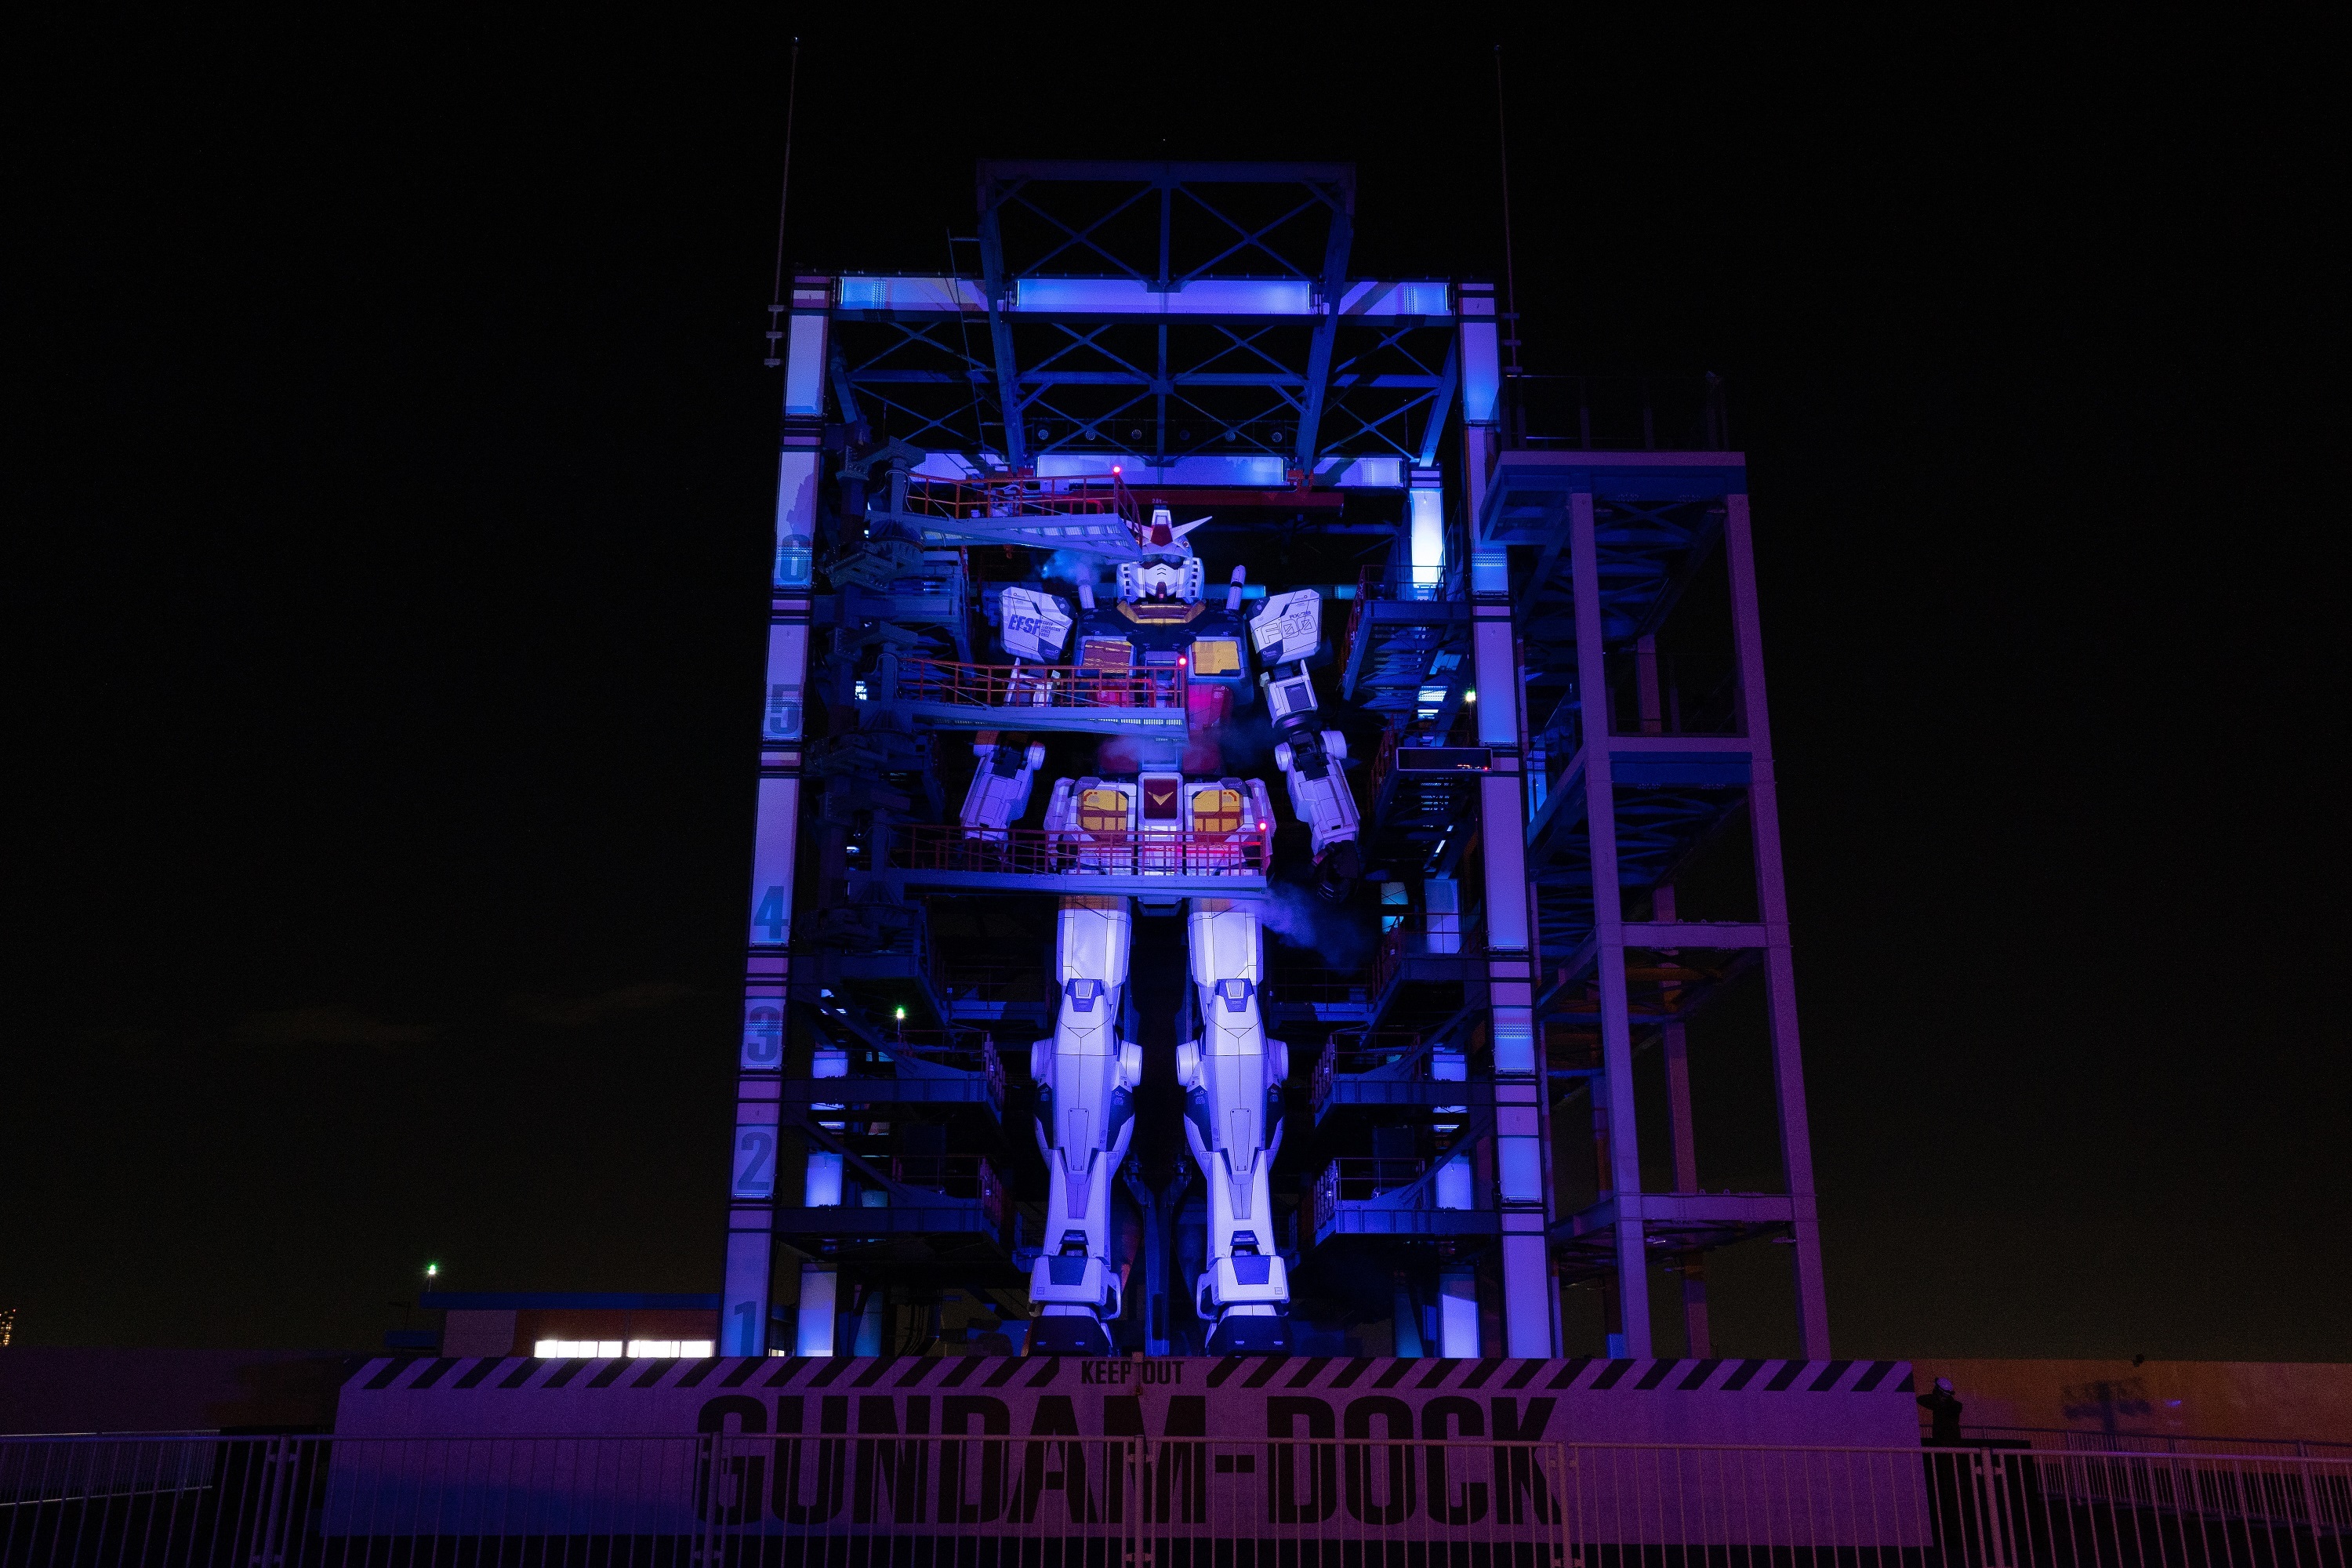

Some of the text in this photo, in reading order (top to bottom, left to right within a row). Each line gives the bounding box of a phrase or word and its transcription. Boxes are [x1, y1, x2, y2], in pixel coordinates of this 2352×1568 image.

[1007, 614, 1043, 636] EFSF
[1289, 610, 1312, 619] RX-78
[770, 684, 800, 734] 5
[753, 885, 789, 939] 4
[747, 1006, 781, 1062] 3
[738, 1132, 772, 1191] 2
[734, 1301, 757, 1356] 1
[1081, 1360, 1185, 1385] KEEP OUT
[696, 1394, 1563, 1526] GUNDAM-DOCK
